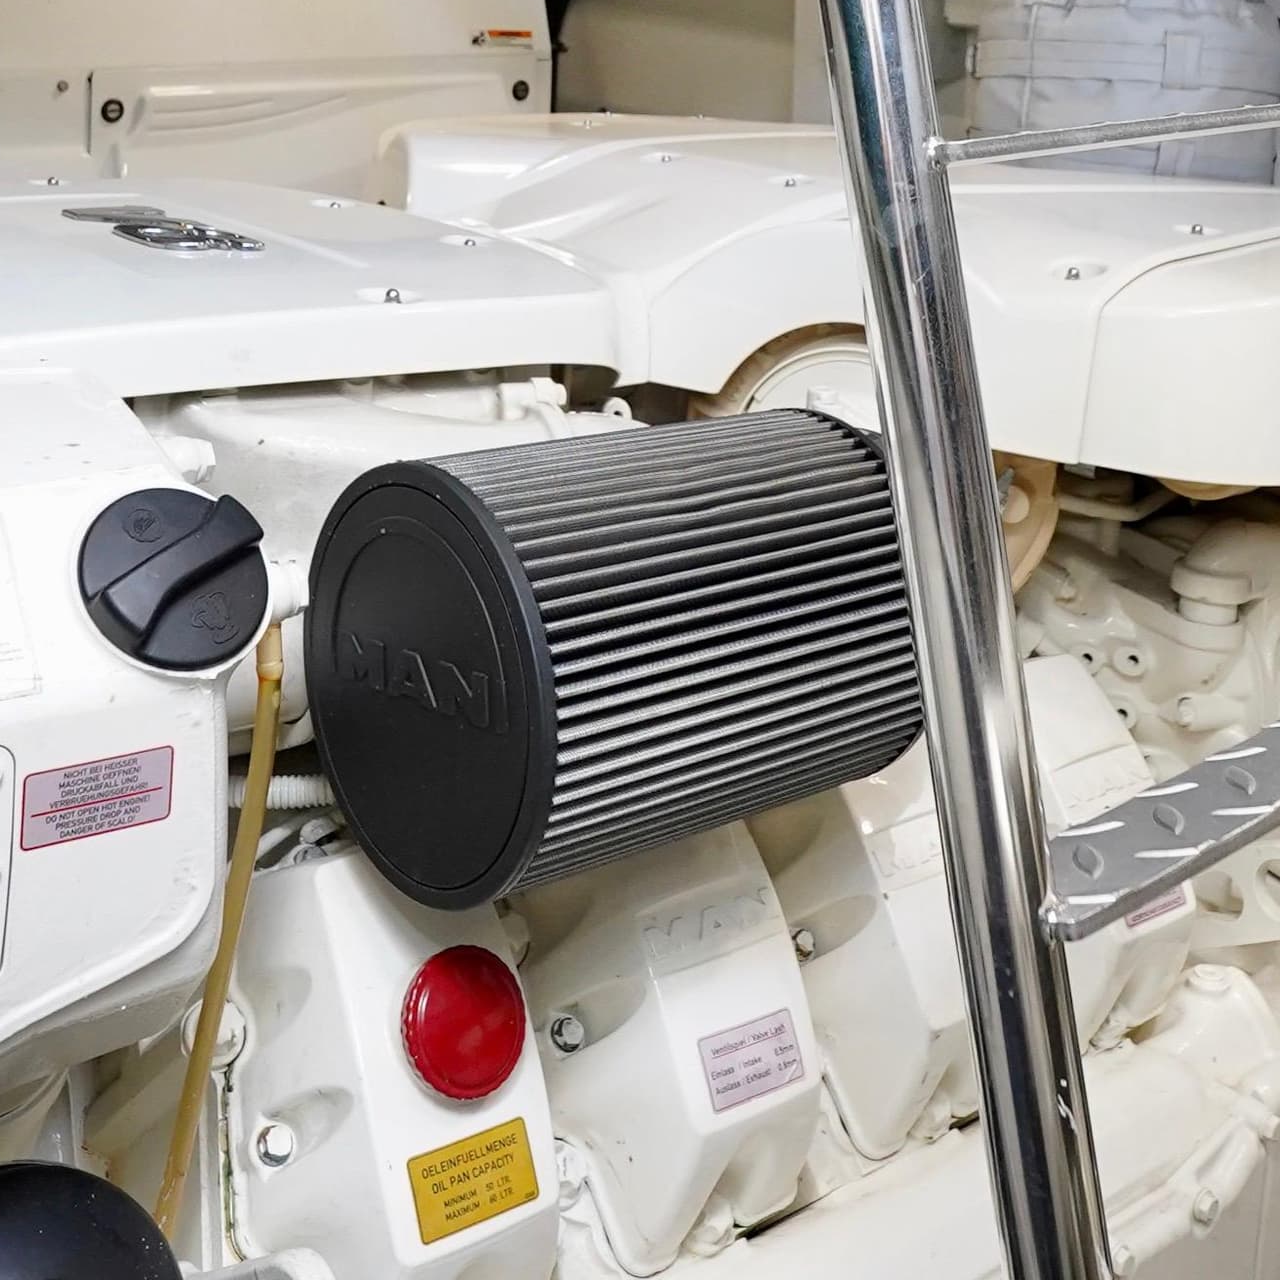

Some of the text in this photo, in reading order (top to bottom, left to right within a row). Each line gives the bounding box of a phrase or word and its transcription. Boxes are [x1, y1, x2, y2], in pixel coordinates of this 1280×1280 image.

[63, 758, 138, 779] NICHT BEI HEISSER
[58, 774, 100, 790] MASCHINE
[61, 775, 139, 798] DRUCKABFALL UND
[45, 816, 57, 824] DO
[59, 811, 76, 821] NOT
[77, 806, 100, 818] OPEN
[101, 802, 119, 812] HOT
[55, 805, 141, 830] PRESSURE DROP AND
[59, 825, 93, 839] DANGER
[95, 822, 105, 830] OF
[421, 1133, 518, 1180] OELEINFUELLMENGE
[431, 1152, 514, 1195] OIL PAN CAPACITY
[443, 1189, 477, 1209] MINIMUM
[445, 1201, 481, 1222] MAXIMUM
